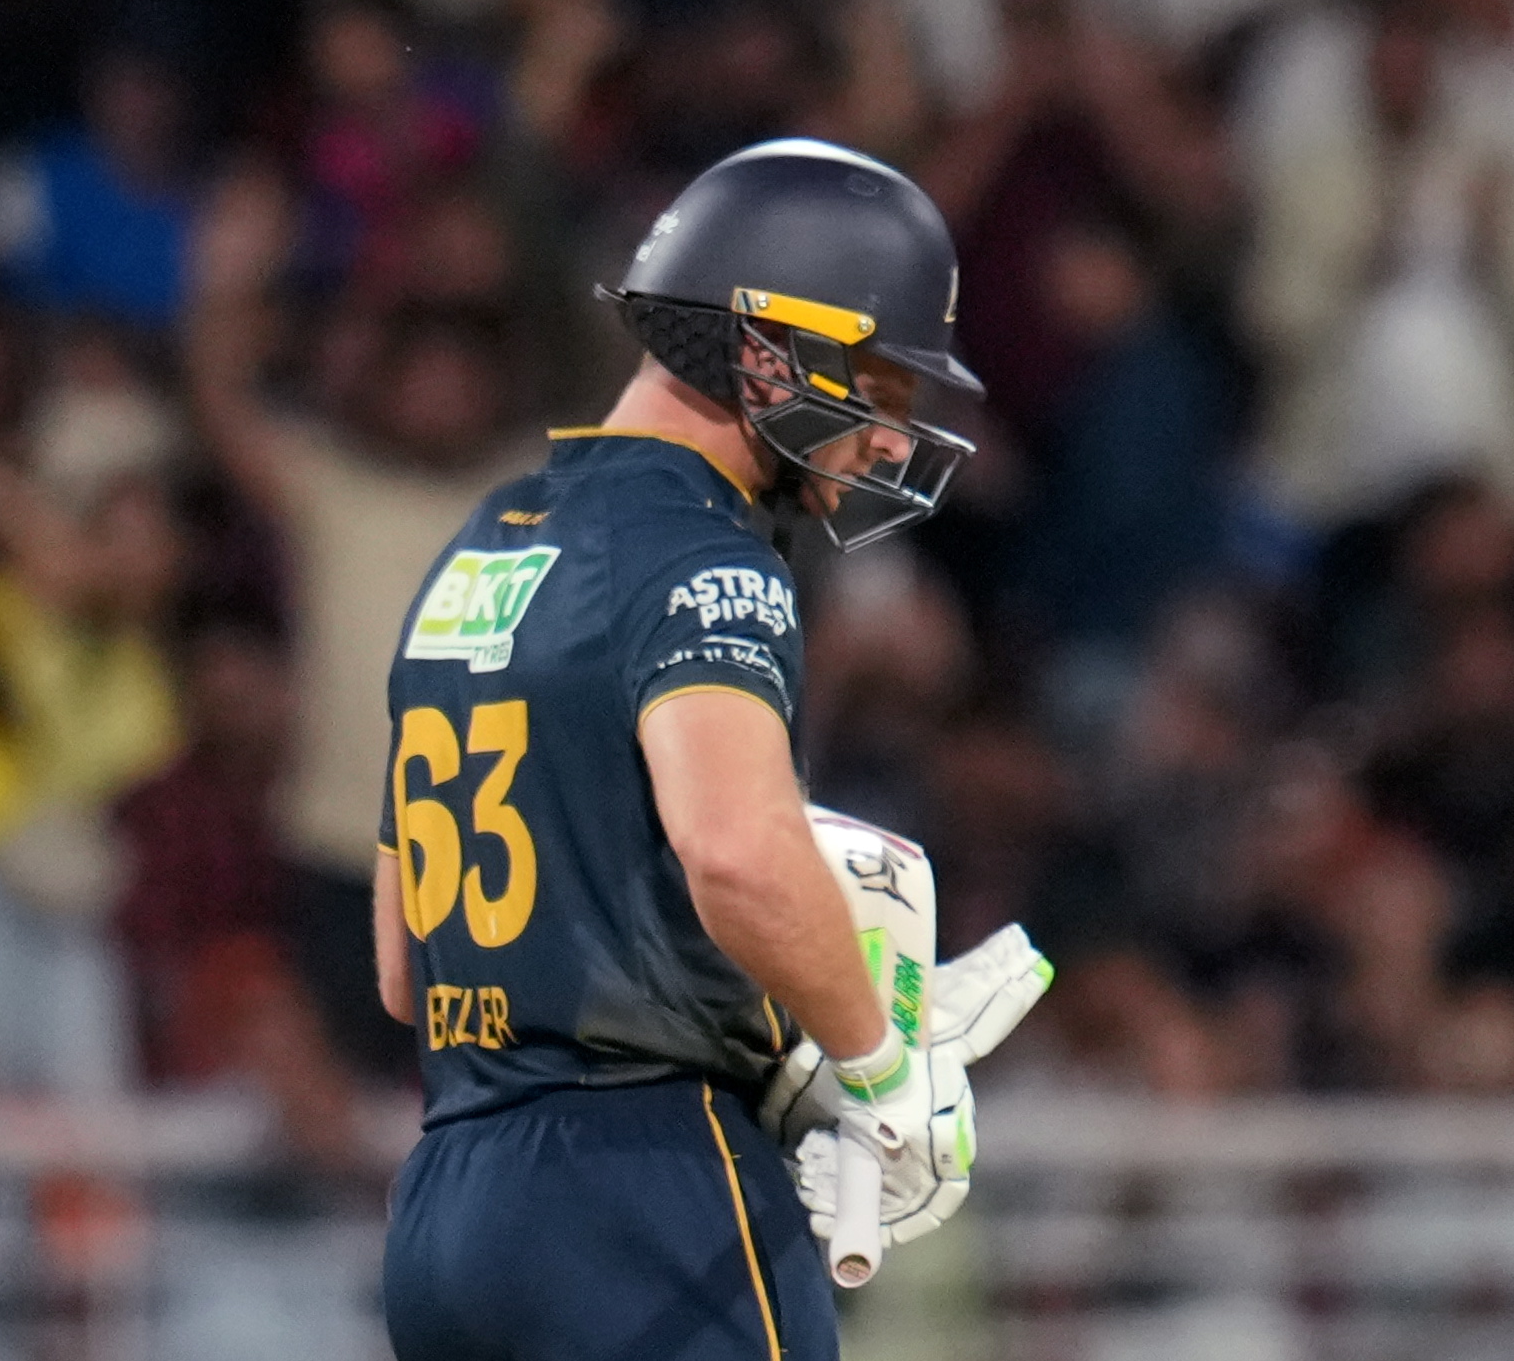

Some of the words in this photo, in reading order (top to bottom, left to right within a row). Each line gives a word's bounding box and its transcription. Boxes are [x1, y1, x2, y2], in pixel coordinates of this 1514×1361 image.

[424, 568, 538, 622] BKT
[699, 598, 787, 636] PIPES
[393, 699, 537, 949] 63
